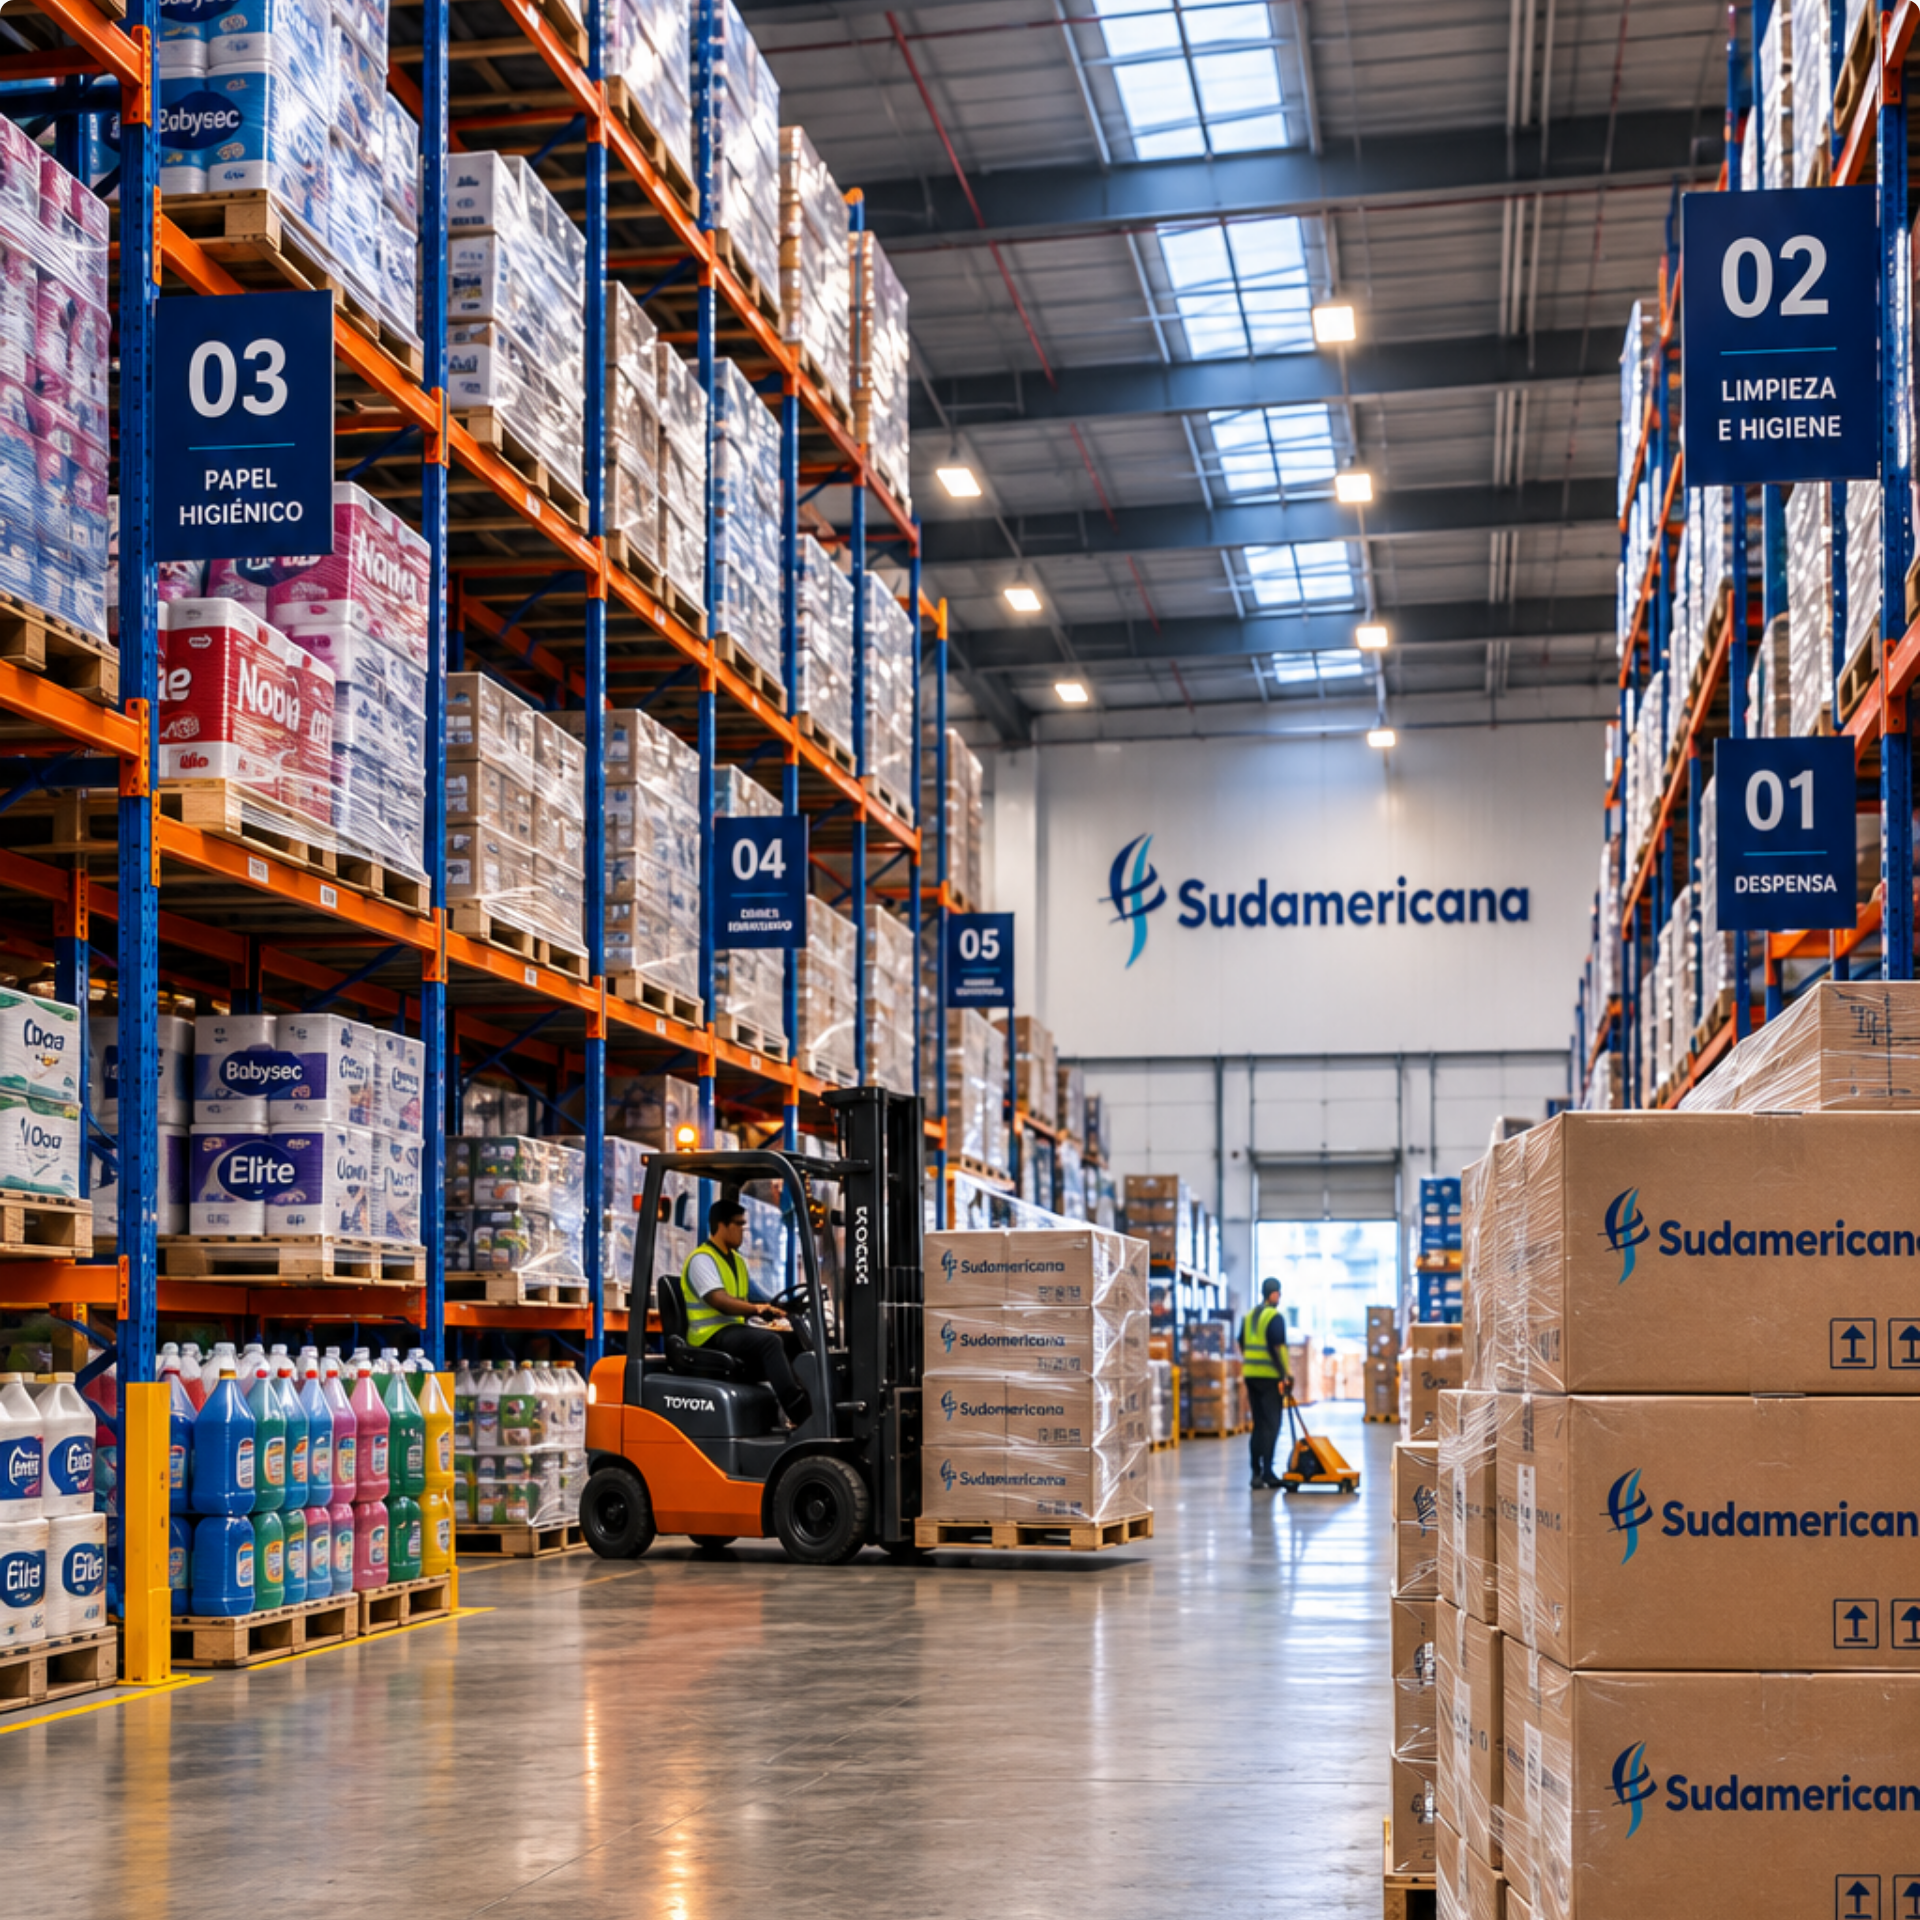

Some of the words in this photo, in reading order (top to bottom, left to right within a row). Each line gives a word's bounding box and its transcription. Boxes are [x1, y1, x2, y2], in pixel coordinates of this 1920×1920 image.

[1721, 234, 1829, 319] 02
[188, 338, 288, 418] 03
[1721, 376, 1837, 402] LIMPIEZA
[1718, 418, 1732, 441] E
[1740, 414, 1842, 441] HIGIENE
[205, 467, 278, 491] PAPEL
[179, 497, 304, 526] HIGIÉNICO
[1745, 769, 1814, 831] 01
[732, 838, 787, 880] 04
[1735, 874, 1838, 895] DESPENSA
[1177, 876, 1530, 929] Sudamericana
[959, 928, 1000, 960] 05
[226, 1061, 303, 1085] Babysec
[229, 1156, 295, 1184] Elite
[1658, 1219, 1920, 1257] Sudamerican
[664, 1396, 716, 1412] TOYOTA
